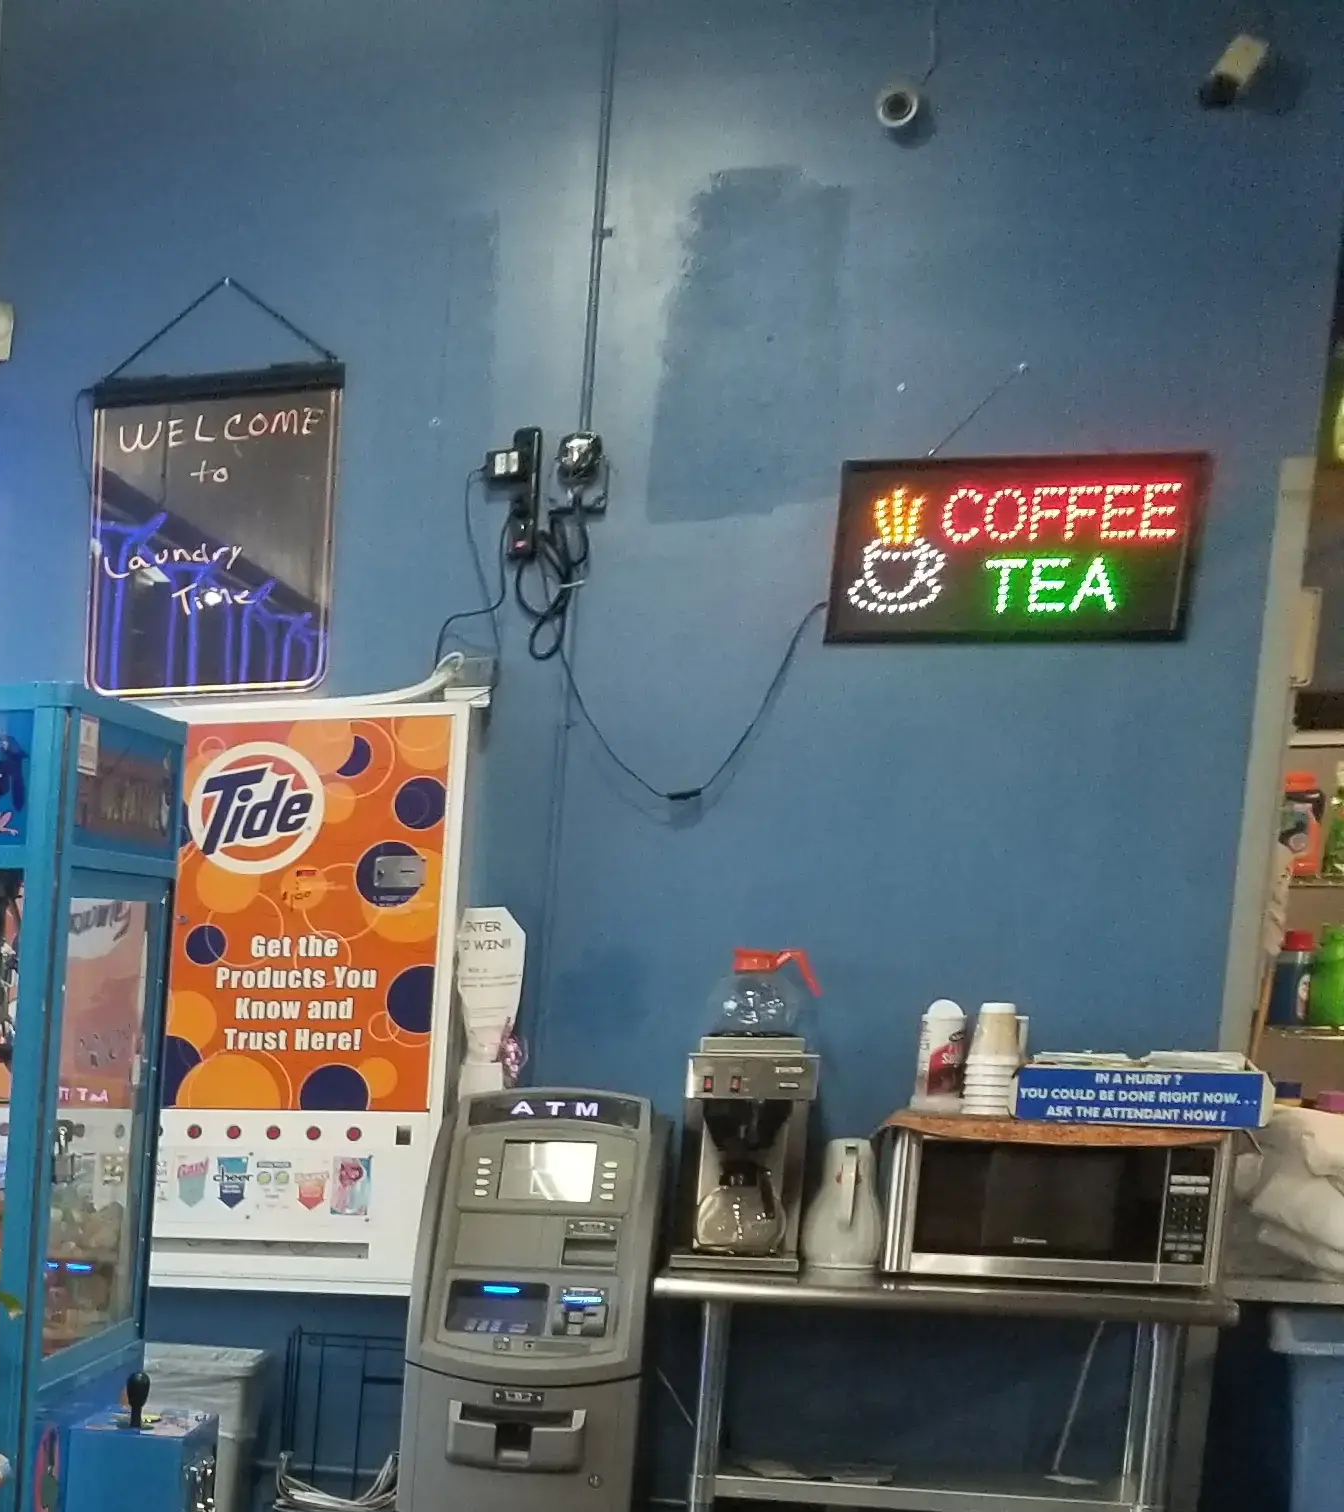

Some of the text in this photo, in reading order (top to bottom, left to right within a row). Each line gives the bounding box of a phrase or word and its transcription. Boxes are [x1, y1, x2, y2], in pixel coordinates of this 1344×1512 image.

[119, 407, 325, 453] WELCOME
[190, 460, 228, 484] to
[941, 482, 1182, 544] COFFEE
[104, 544, 244, 578] Laundry
[985, 553, 1117, 614] TEA
[201, 762, 314, 856] Tide
[251, 936, 338, 958] Get the
[216, 966, 377, 989] Products You
[235, 997, 354, 1020] Know and
[224, 1028, 362, 1051] Trust Here!
[1095, 1072, 1110, 1084] IN
[1112, 1073, 1122, 1085] A
[1125, 1074, 1171, 1086] HURRY
[1020, 1087, 1048, 1099] YOU
[1051, 1088, 1096, 1101] COULD
[1099, 1089, 1115, 1101] BE
[1118, 1091, 1155, 1102] DONE
[1159, 1092, 1200, 1104] RIGHT
[512, 1100, 599, 1117] ATM
[1046, 1105, 1072, 1117] ASK
[1076, 1106, 1100, 1118] THE
[1102, 1107, 1179, 1120] ATTENDANT
[1183, 1109, 1218, 1122] HOW
[213, 1165, 253, 1182] cheer
